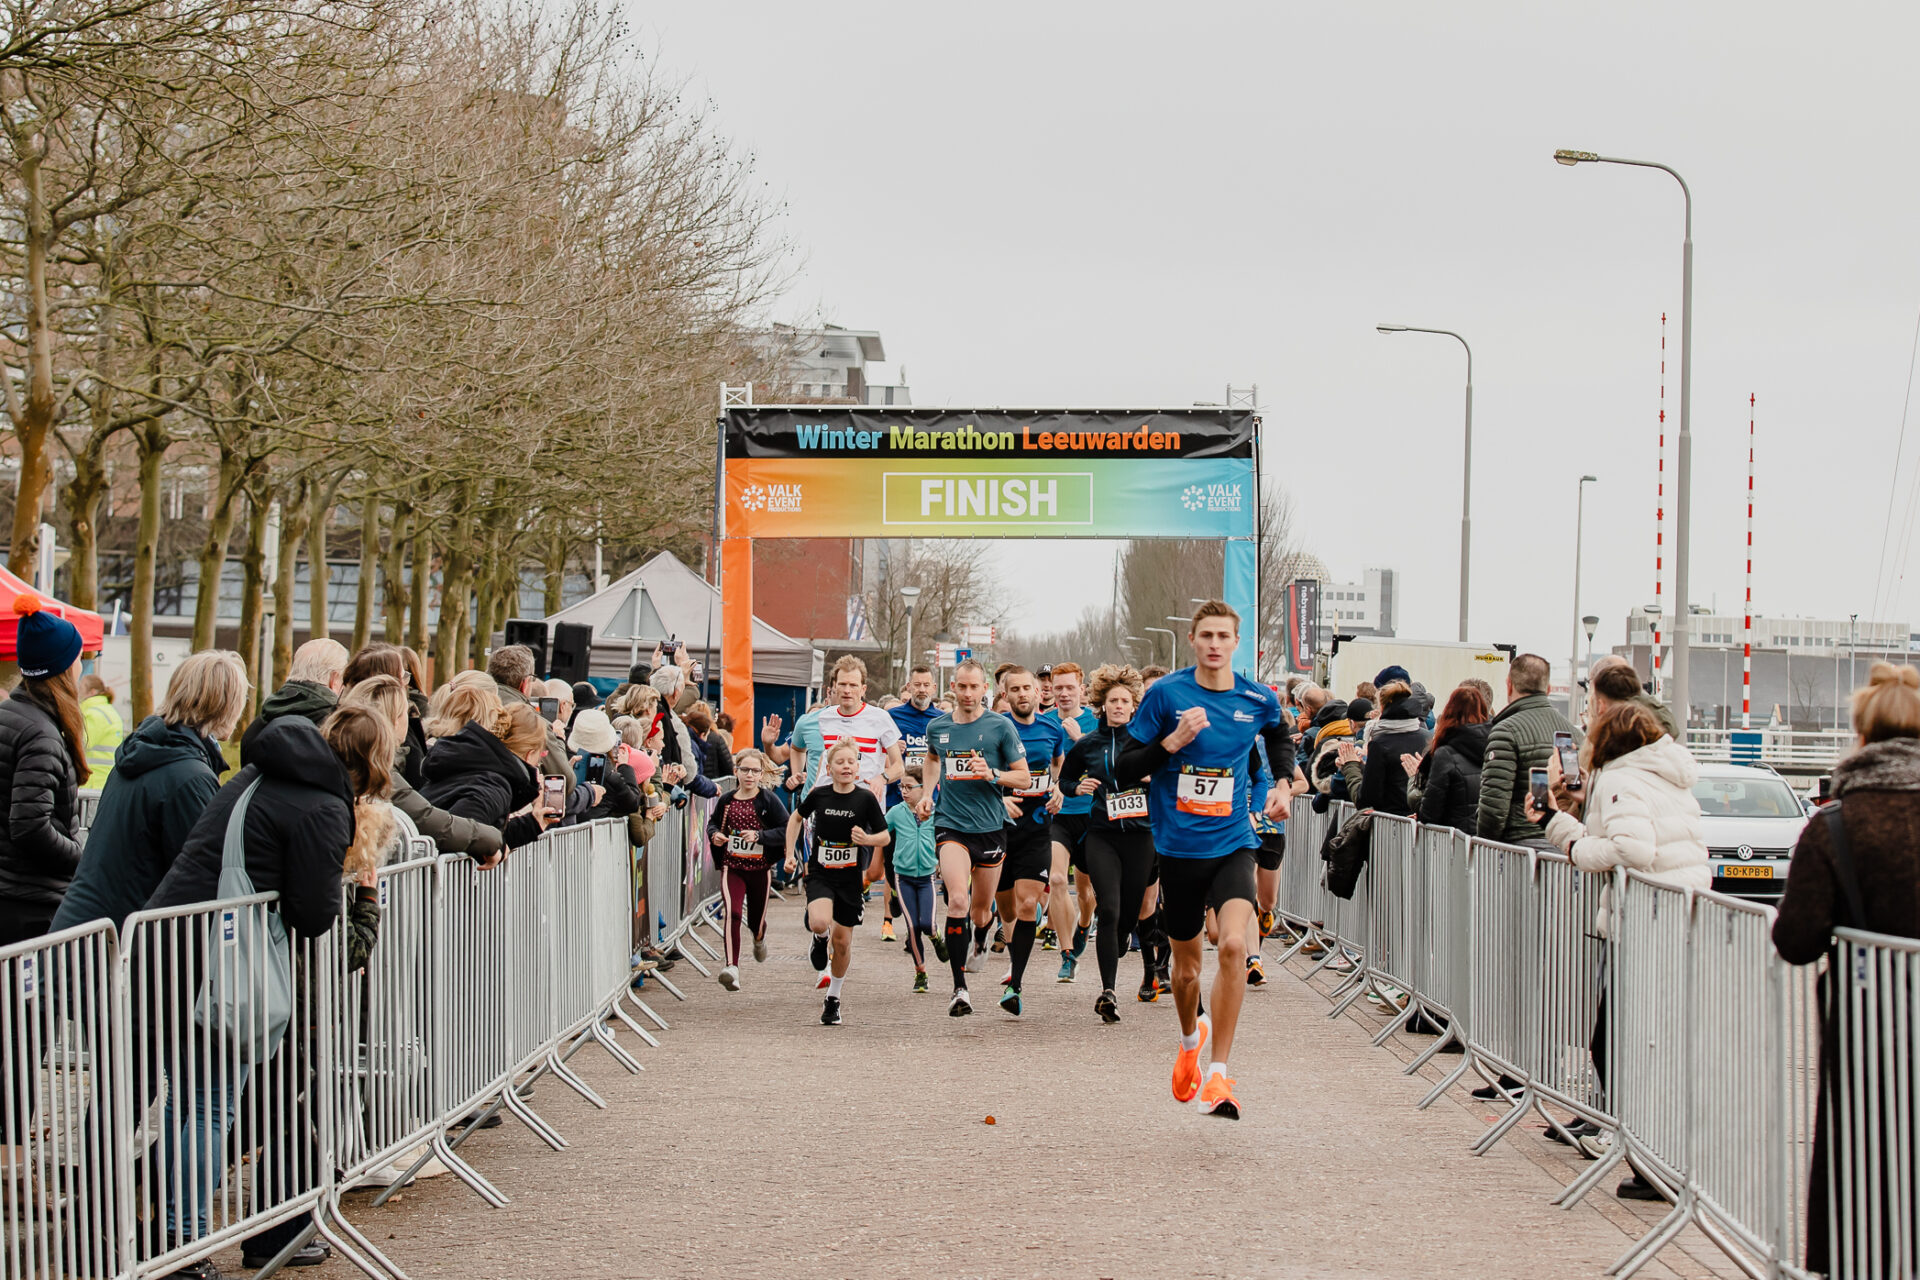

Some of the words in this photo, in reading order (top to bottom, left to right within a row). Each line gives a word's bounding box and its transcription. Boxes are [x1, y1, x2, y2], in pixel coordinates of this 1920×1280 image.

[796, 424, 882, 450] Winter
[889, 424, 1015, 450] Marathon
[1022, 424, 1181, 450] Leeuwarden
[767, 484, 803, 497] VALK
[1207, 484, 1242, 497] VALK
[767, 496, 803, 507] EVENT
[920, 478, 1058, 517] FINISH
[1207, 496, 1242, 507] EVENT
[1194, 778, 1219, 796] 57
[1110, 796, 1143, 812] 1033
[824, 809, 849, 817] CRAFT
[732, 837, 756, 851] 507
[824, 848, 851, 861] 506
[1726, 866, 1770, 877] 50-KPB-8
